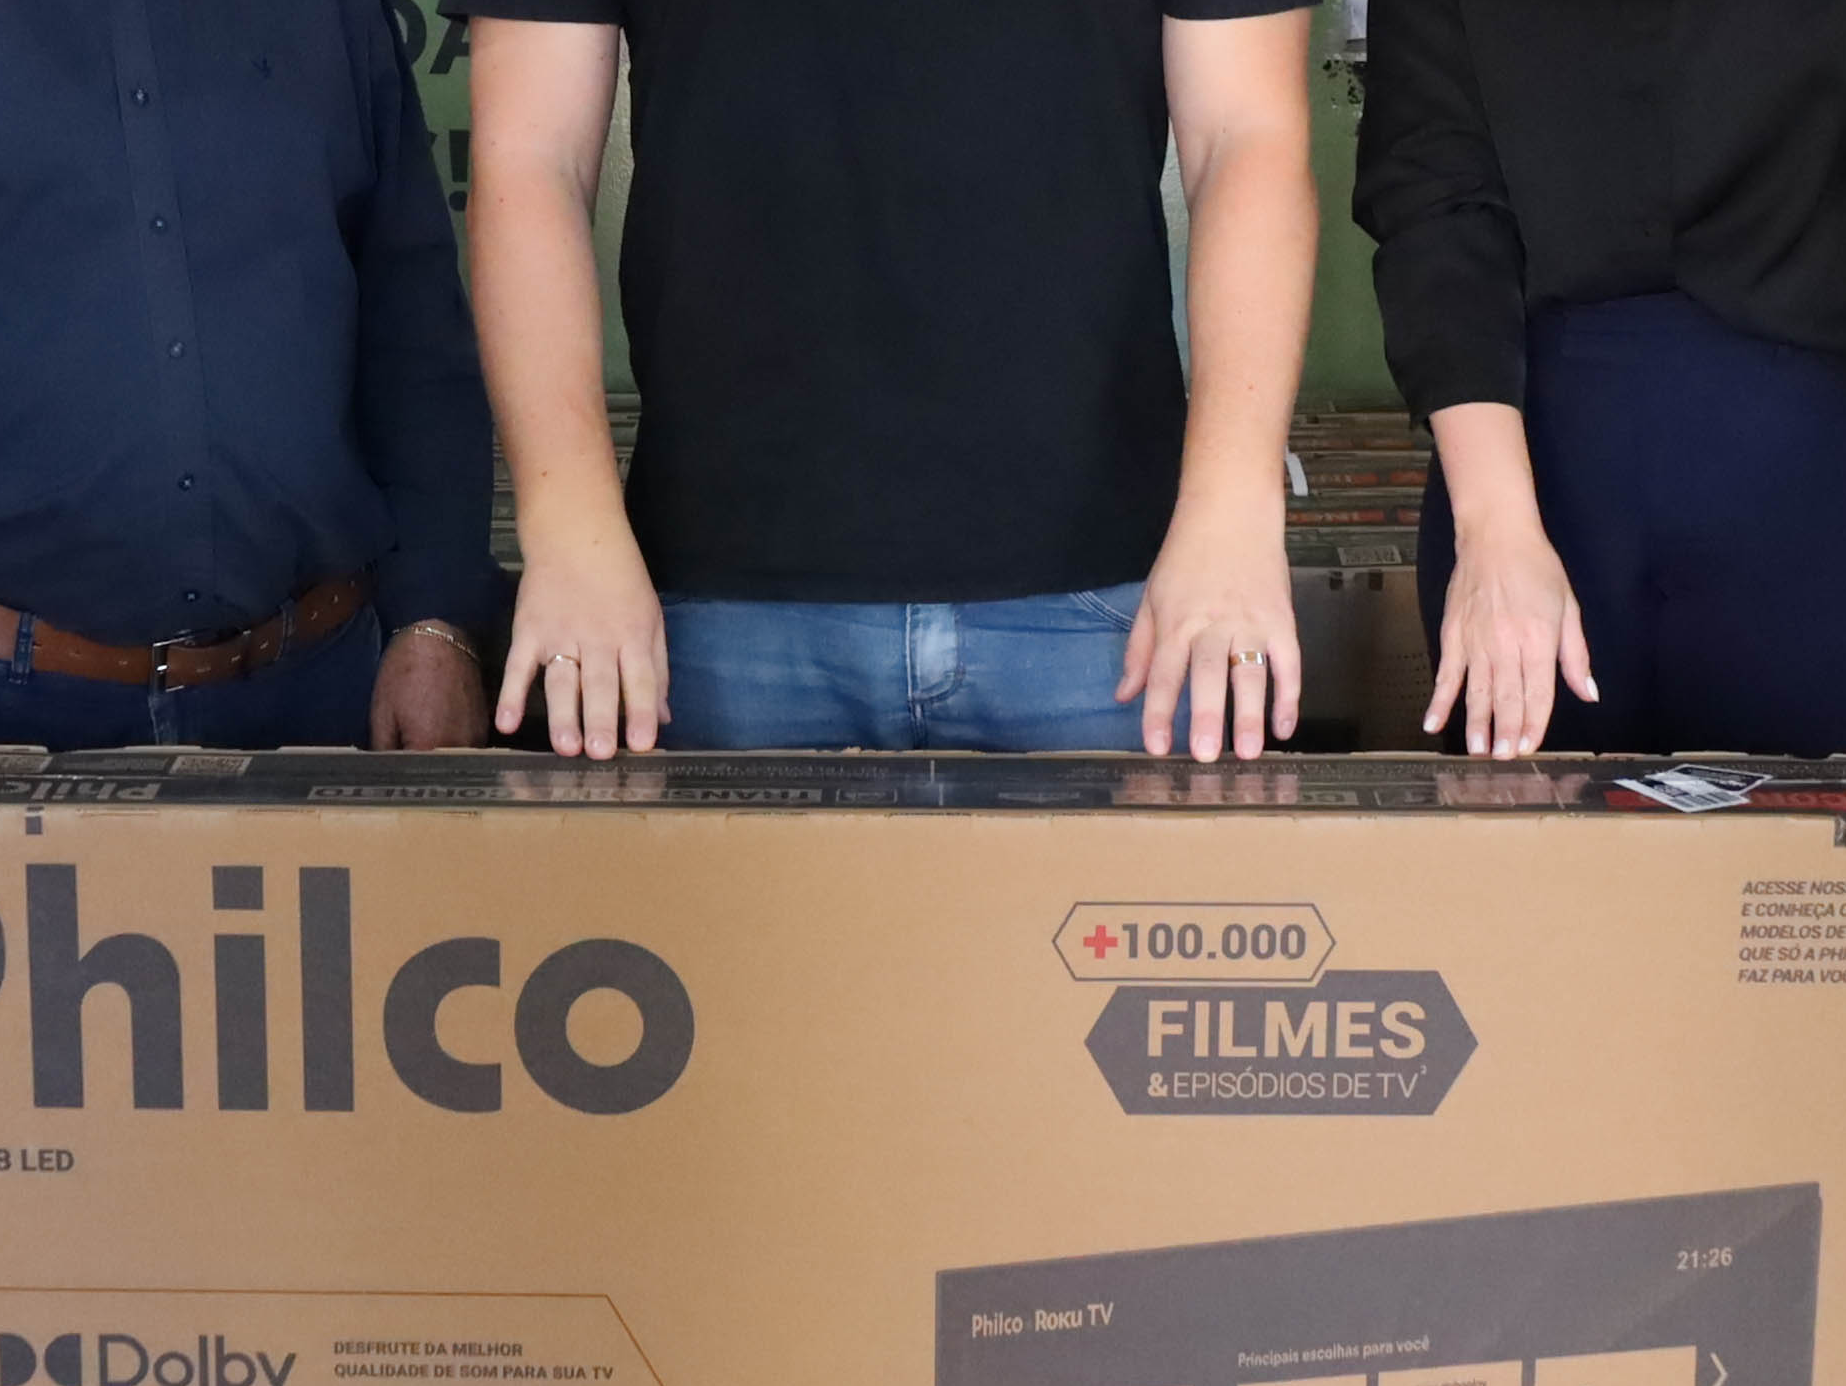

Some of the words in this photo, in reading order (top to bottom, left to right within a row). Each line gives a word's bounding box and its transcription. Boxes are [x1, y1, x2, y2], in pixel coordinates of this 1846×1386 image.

[1742, 881, 1806, 895] ACESSE
[1741, 903, 1752, 917] E
[1755, 903, 1835, 920] CONHEÇA
[1740, 925, 1822, 939] MODELOS
[1825, 925, 1846, 939] DE
[1739, 947, 1773, 962] QUE
[1777, 944, 1801, 961] SÓ
[1804, 947, 1815, 961] A
[1738, 969, 1769, 983] FAZ
[1772, 969, 1815, 983] PARA
[1147, 1000, 1427, 1059] FILMES
[1173, 1066, 1325, 1099] EPISÓDIOS
[1333, 1073, 1371, 1099] DE
[21, 1148, 75, 1172] LED
[1676, 1247, 1733, 1270] 21:26
[971, 1313, 1023, 1338] Philco
[1087, 1302, 1114, 1327] TV
[334, 1341, 420, 1356] DESFRUTE
[425, 1342, 447, 1356] DA
[452, 1342, 523, 1357] MELHOR
[1238, 1349, 1299, 1368] Principais
[1302, 1343, 1359, 1361] escolhas
[1363, 1343, 1394, 1358] para
[1397, 1335, 1430, 1353] você
[334, 1364, 429, 1379] QUALIDADE
[433, 1365, 452, 1379] DE
[460, 1365, 498, 1379] SOM
[502, 1365, 547, 1380] PARA
[553, 1366, 586, 1380] SUA
[592, 1366, 614, 1380] TV
